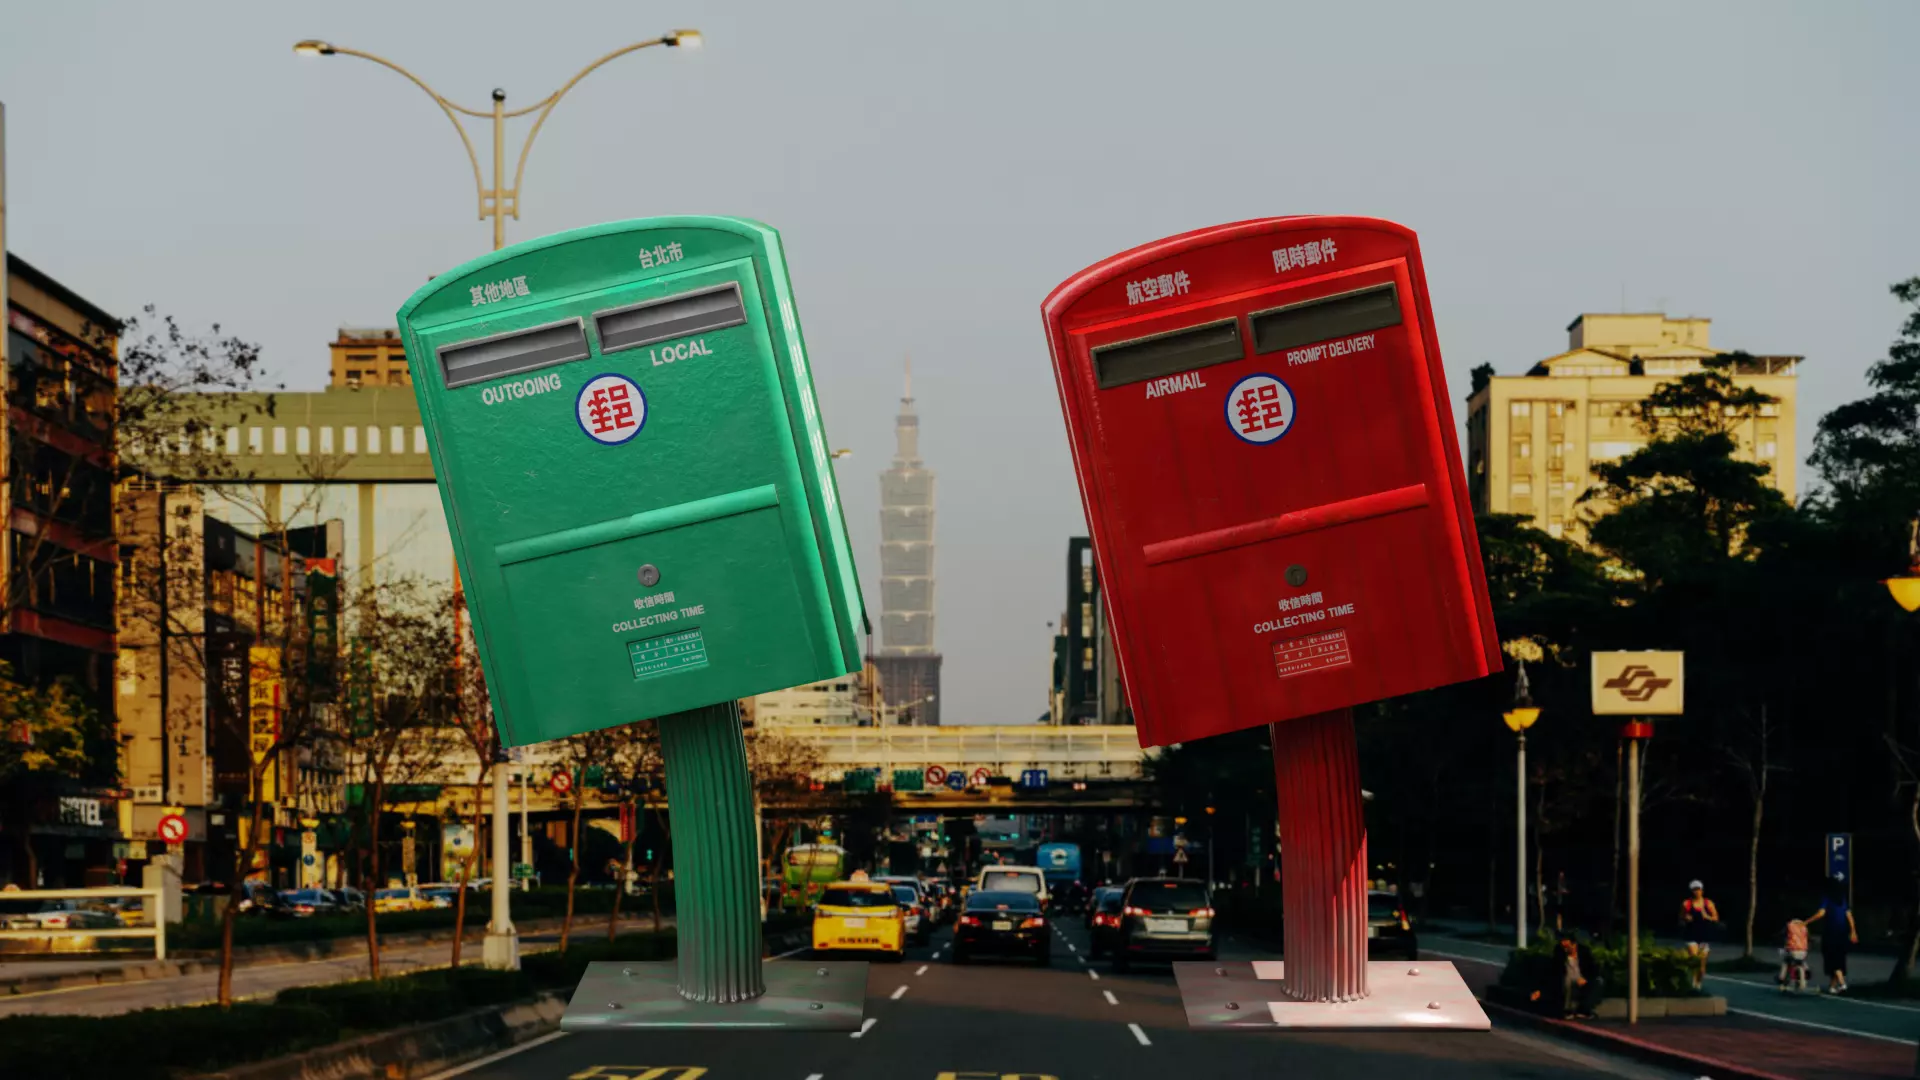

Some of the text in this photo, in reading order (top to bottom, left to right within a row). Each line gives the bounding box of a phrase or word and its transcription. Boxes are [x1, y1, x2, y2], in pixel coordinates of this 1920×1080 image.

[638, 241, 684, 269] 台北市
[1271, 237, 1338, 274] 限時郵件
[469, 275, 531, 307] 其他地區
[1126, 270, 1191, 306] 航空郵件
[650, 338, 714, 367] LOCAL
[1286, 334, 1376, 367] PROMPT DELIVERY
[481, 373, 562, 406] OUTGOING
[1145, 371, 1207, 400] AIRMAIL
[633, 591, 676, 610] 收信時間
[1278, 591, 1324, 612] 收信時間
[612, 604, 705, 633] COLLECTING TIME
[1253, 602, 1355, 634] COLLECTING TIME
[1832, 836, 1845, 852] P
